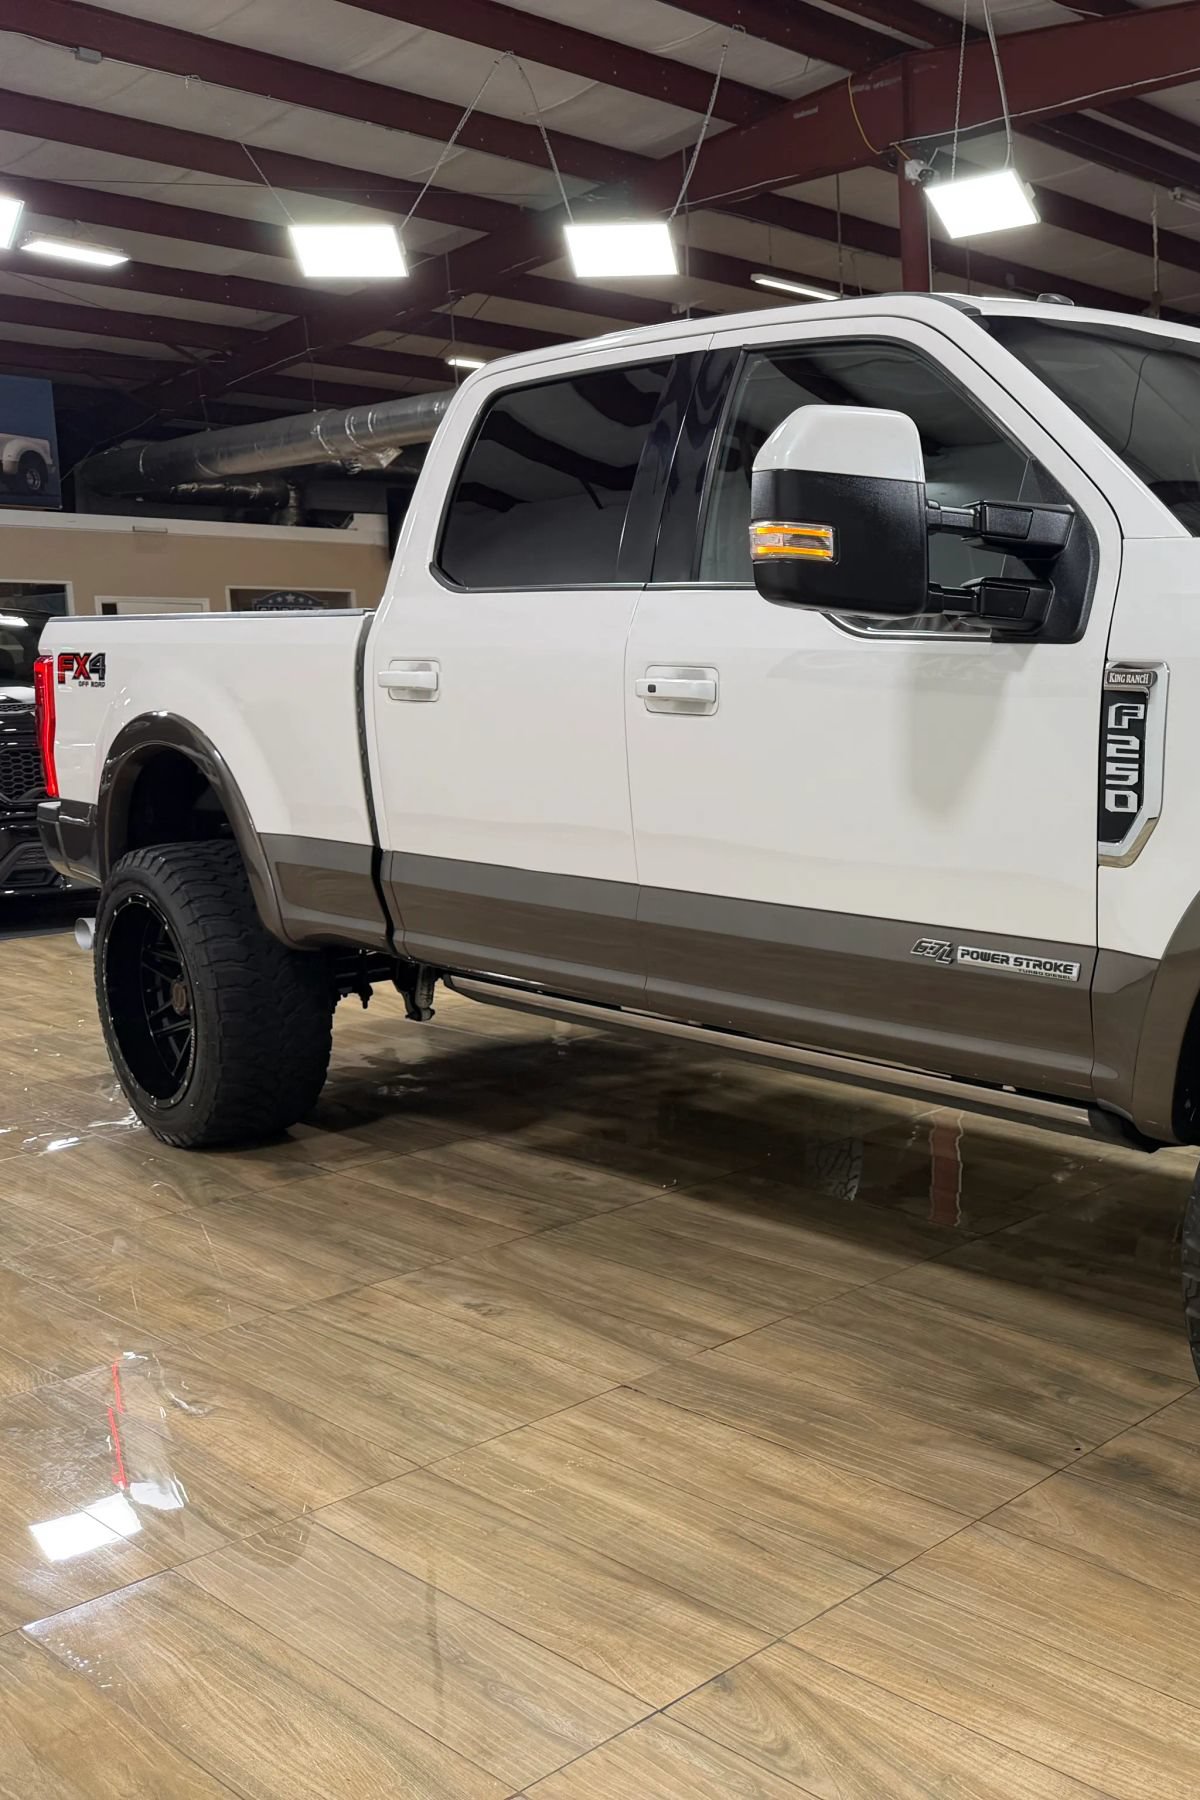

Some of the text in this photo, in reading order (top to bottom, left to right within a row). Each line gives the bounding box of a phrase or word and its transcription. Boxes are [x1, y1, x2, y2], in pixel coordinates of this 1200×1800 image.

[57, 652, 106, 685] FX4
[1109, 672, 1149, 684] KING RANCH
[960, 948, 1010, 965] POWER
[1013, 957, 1075, 975] STROKE
[1017, 968, 1071, 980] TURBO DIESEL
